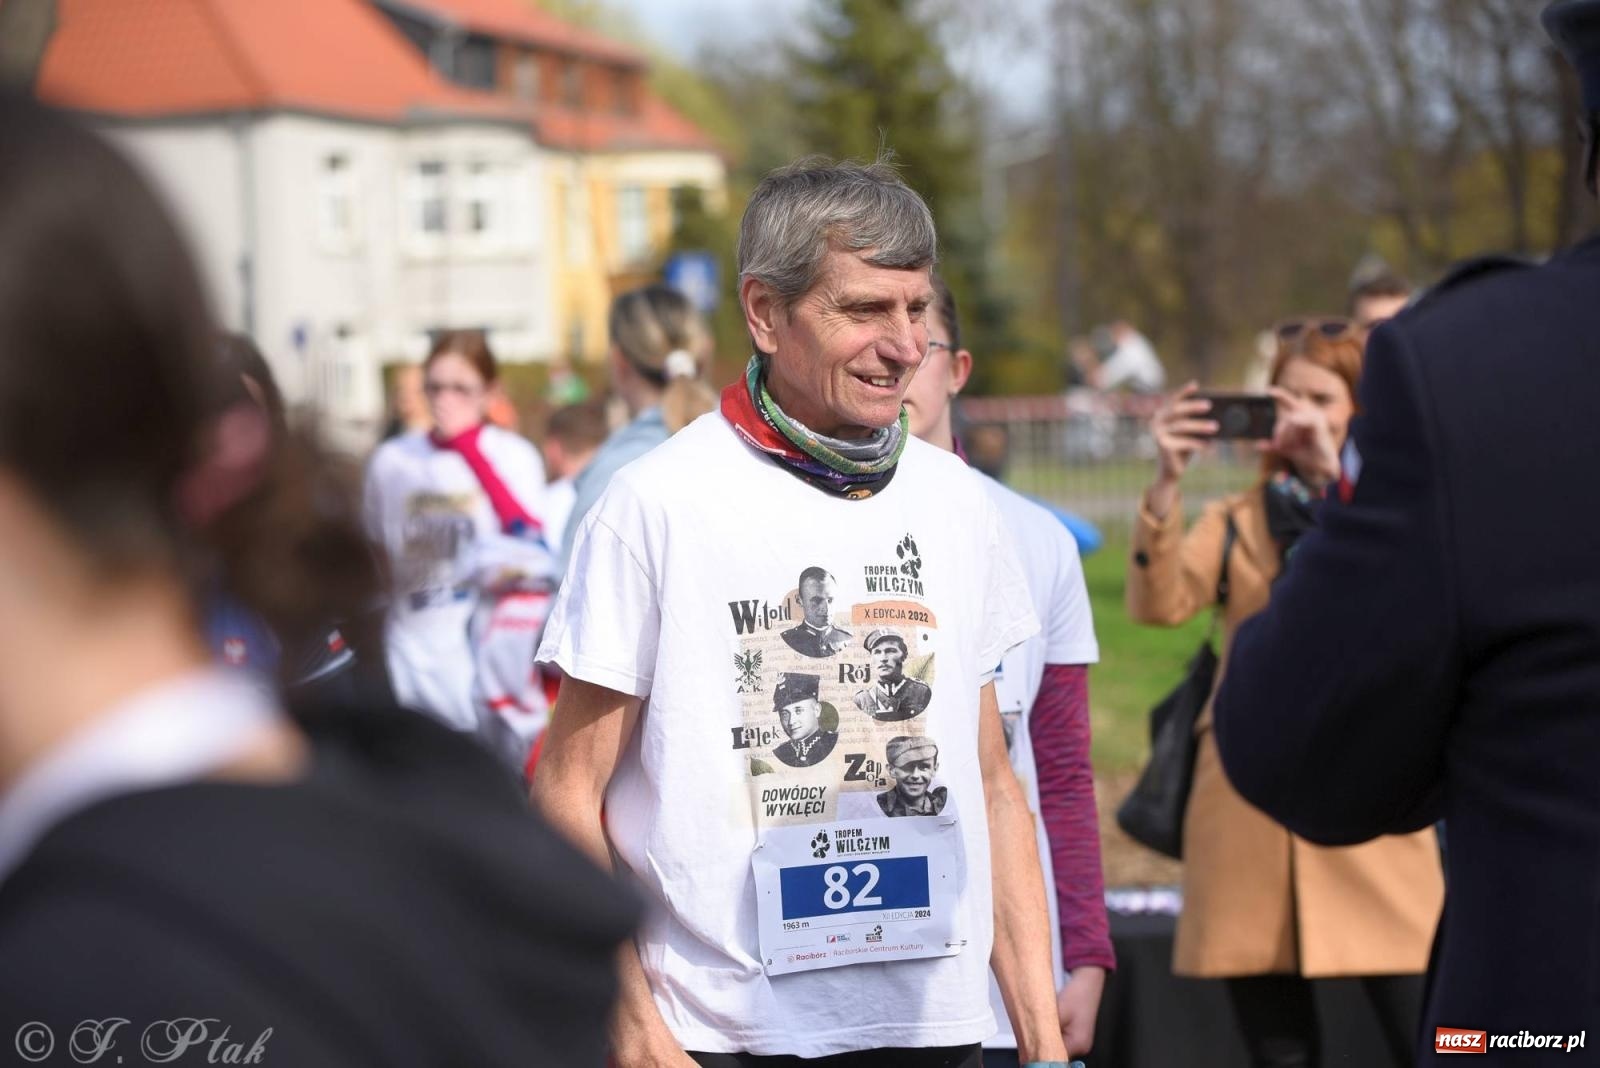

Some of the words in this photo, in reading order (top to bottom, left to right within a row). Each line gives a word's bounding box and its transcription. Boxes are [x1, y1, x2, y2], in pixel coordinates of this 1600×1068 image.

[864, 565, 898, 576] TROPEM
[865, 576, 924, 597] WILCZYM
[728, 597, 792, 635] Witold
[864, 608, 871, 619] X
[873, 608, 906, 620] EDYCJA
[908, 610, 929, 623] 2022
[838, 662, 873, 684] Rój
[762, 785, 827, 803] DOWÓDCY
[766, 800, 826, 818] WYKLĘCI
[834, 828, 863, 839] TROPEM
[836, 836, 890, 854] WILCZYM
[823, 863, 882, 910] 82
[914, 909, 931, 919] 2024
[783, 921, 800, 931] 1963
[796, 952, 827, 962] Racibórz
[869, 944, 899, 954] Centrum
[899, 942, 925, 952] Kultury
